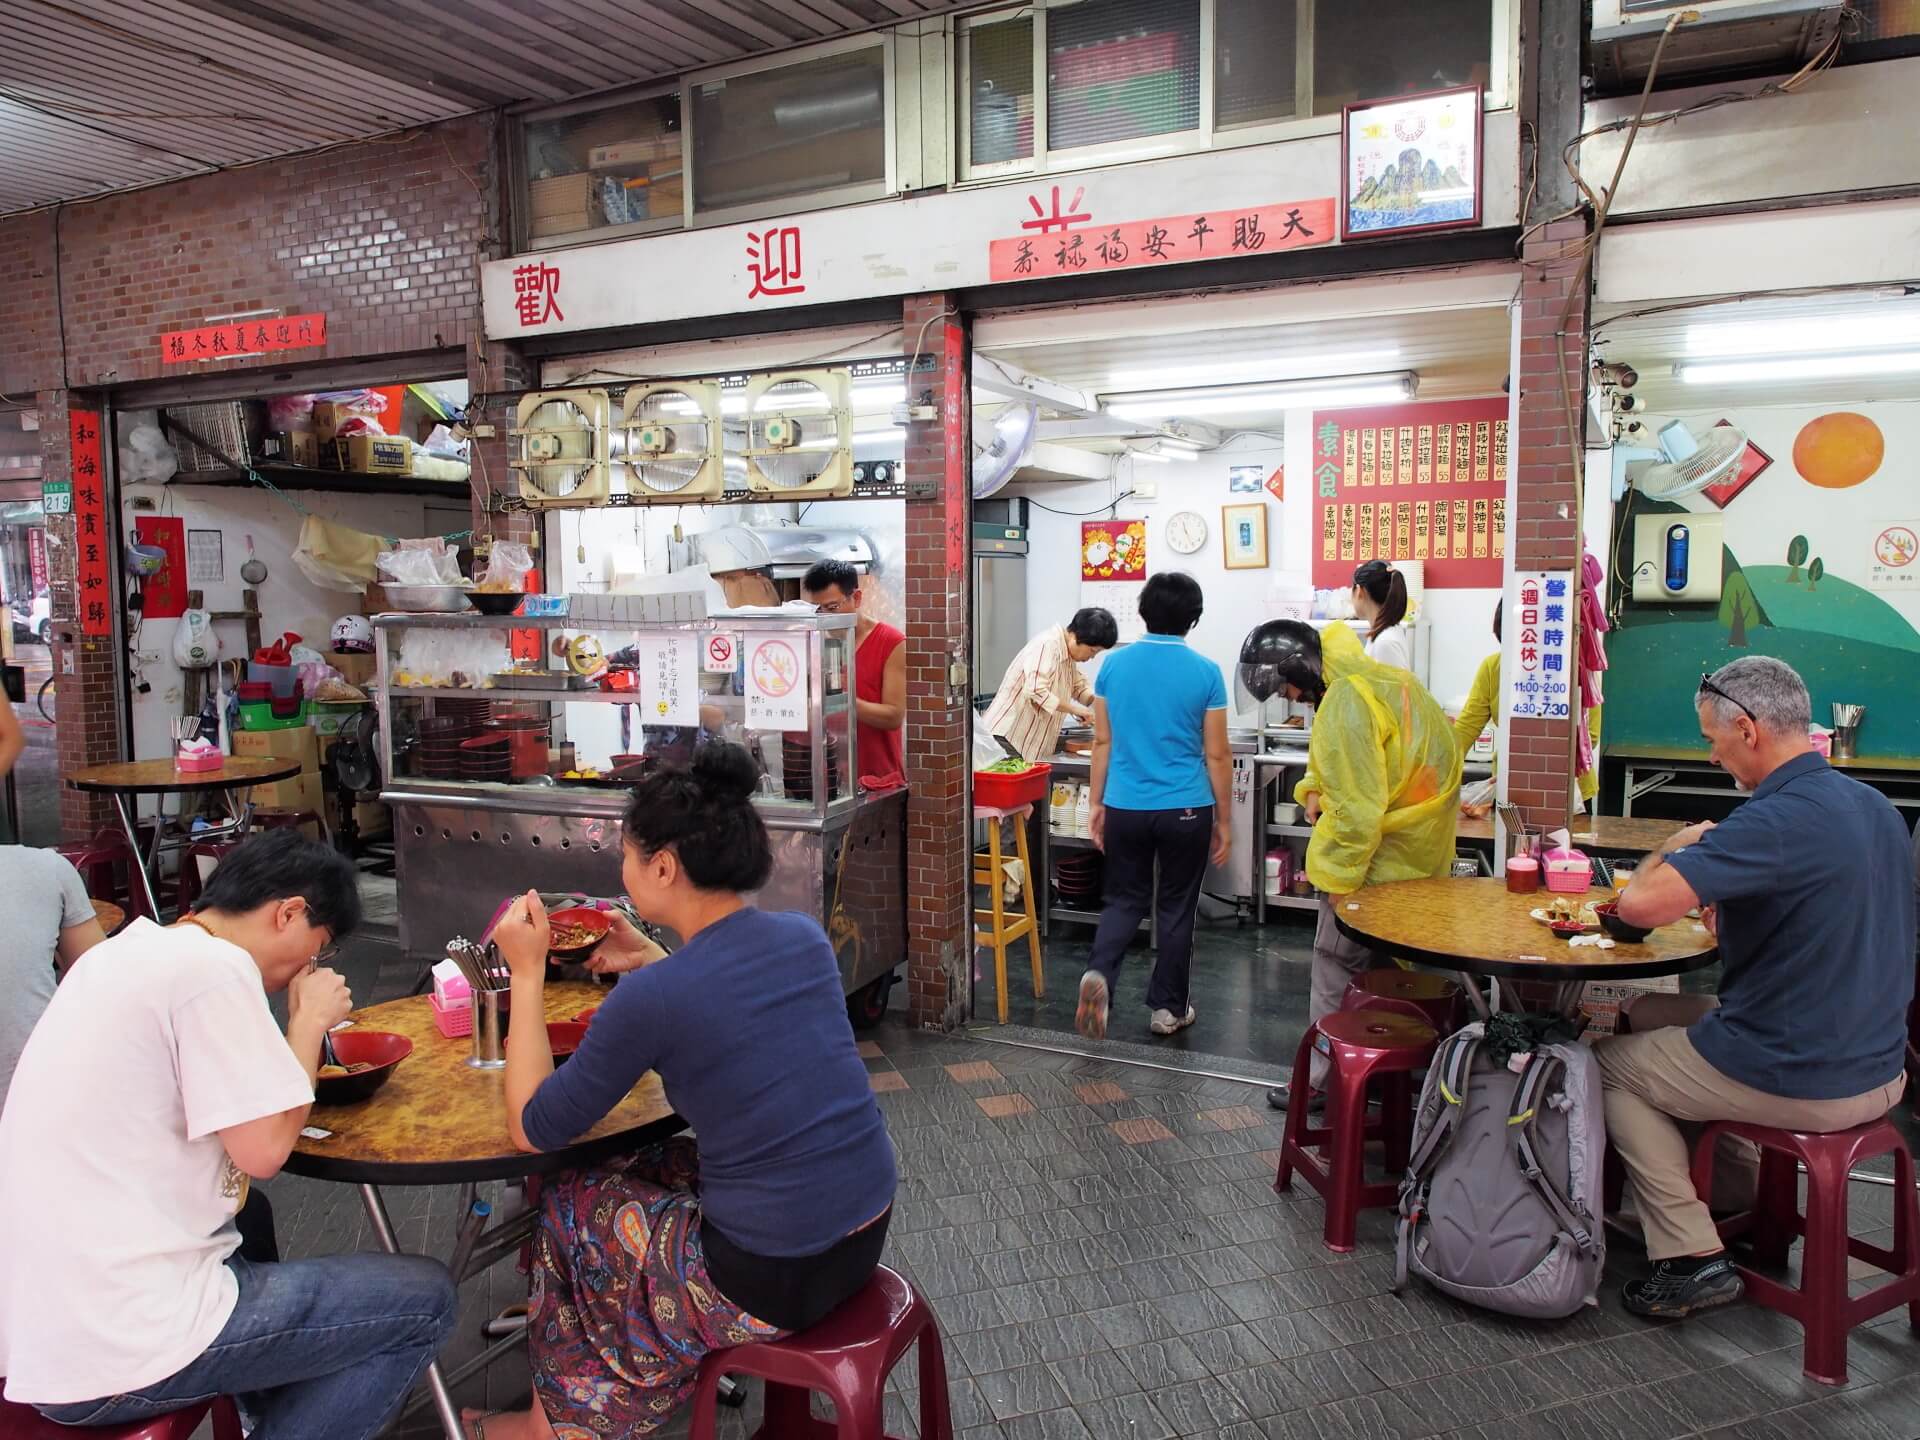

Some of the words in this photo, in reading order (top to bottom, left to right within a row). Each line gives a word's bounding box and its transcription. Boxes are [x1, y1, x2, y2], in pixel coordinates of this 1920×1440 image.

[1314, 420, 1342, 498] 素食
[1419, 471, 1430, 481] 55
[1438, 471, 1449, 481] 55
[1457, 470, 1468, 480] 65
[1476, 469, 1487, 479] 65
[46, 495, 70, 511] 219
[1361, 549, 1371, 559] 50
[1397, 550, 1408, 559] 50
[1416, 547, 1427, 557] 40
[1435, 546, 1447, 556] 40
[1455, 547, 1466, 556] 50
[1474, 546, 1486, 556] 50
[1542, 579, 1566, 672] 營業時間
